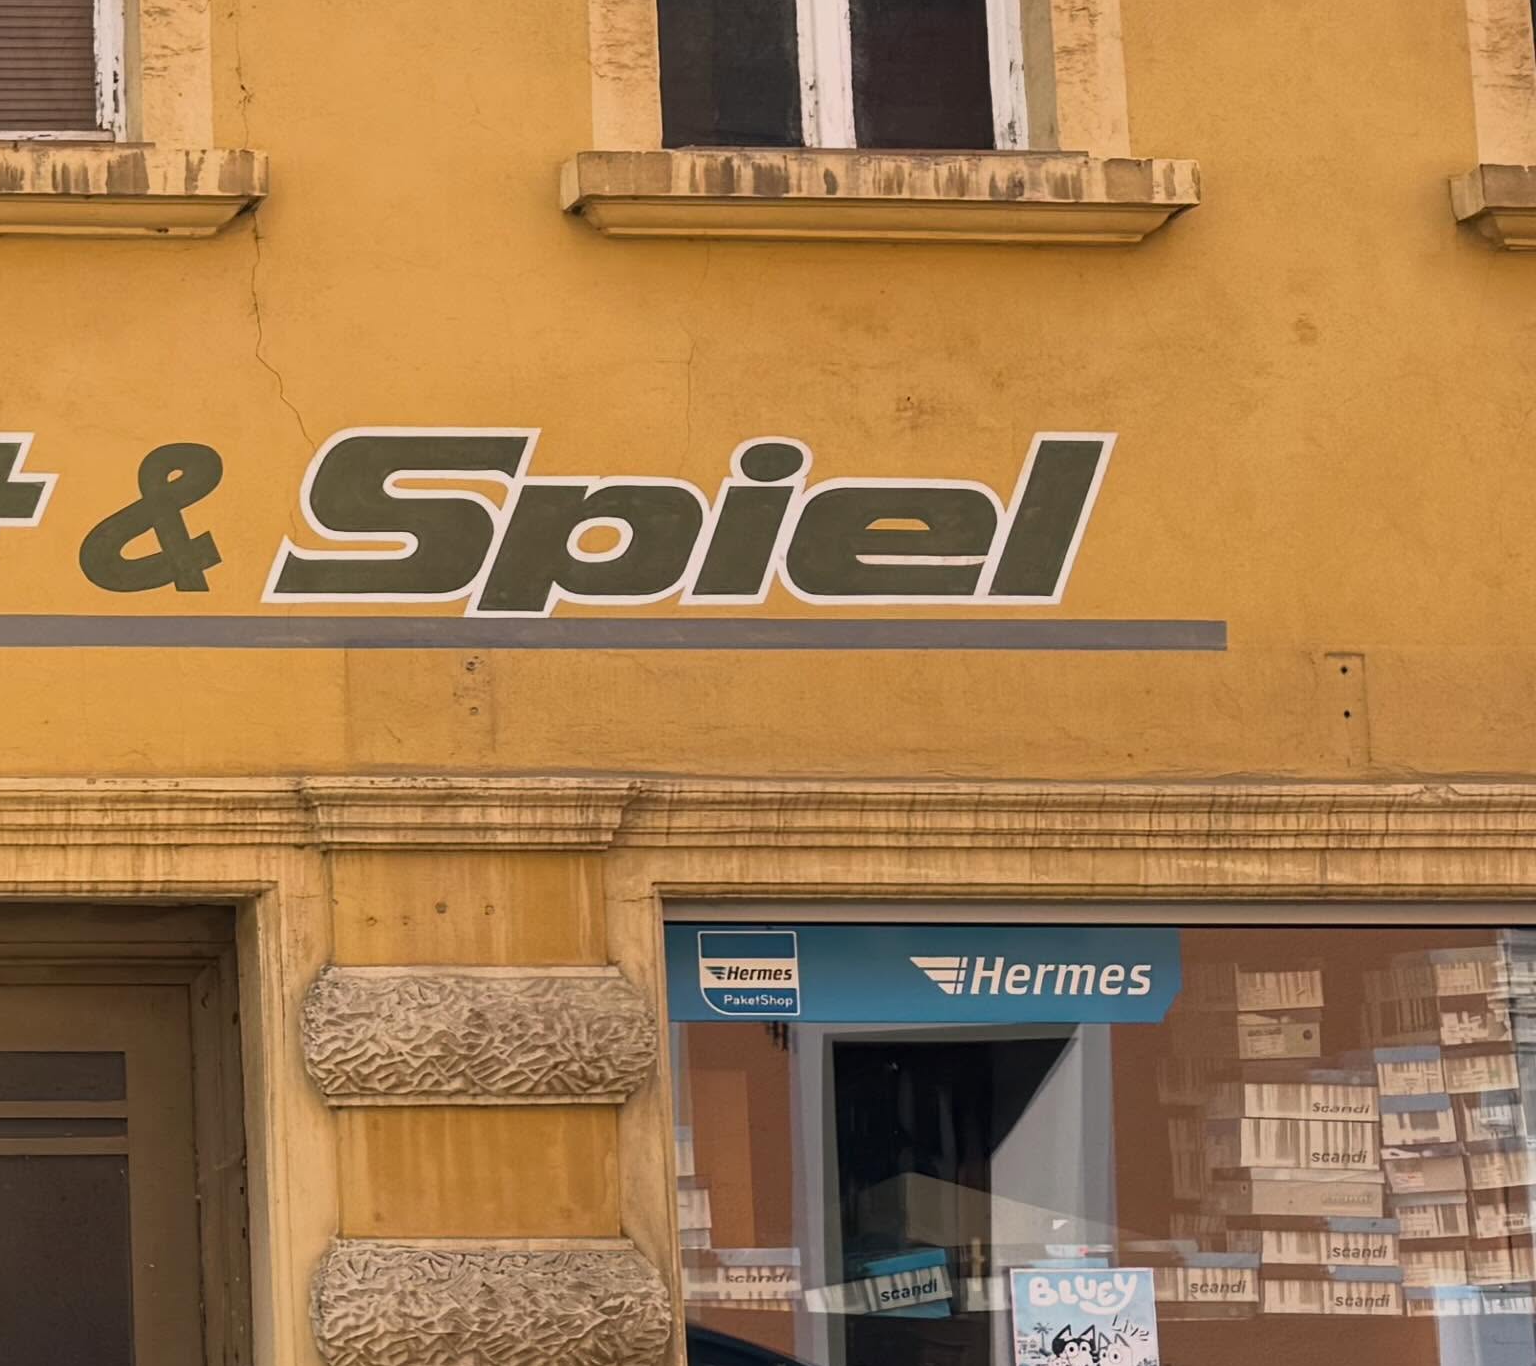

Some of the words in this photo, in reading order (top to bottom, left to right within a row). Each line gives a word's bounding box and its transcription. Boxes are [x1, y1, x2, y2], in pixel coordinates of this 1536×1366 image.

[78, 442, 223, 593] &
[261, 426, 1117, 619] Spiel
[725, 965, 793, 982] Hermes
[969, 956, 1152, 996] Hermes
[723, 994, 794, 1009] PaketShop
[1311, 1150, 1368, 1164] scandi
[1332, 1245, 1388, 1260] scandi
[881, 1278, 938, 1303] scandi
[1028, 1273, 1137, 1316] BLUEY
[1190, 1280, 1247, 1295] scandi
[1335, 1294, 1391, 1308] scandi
